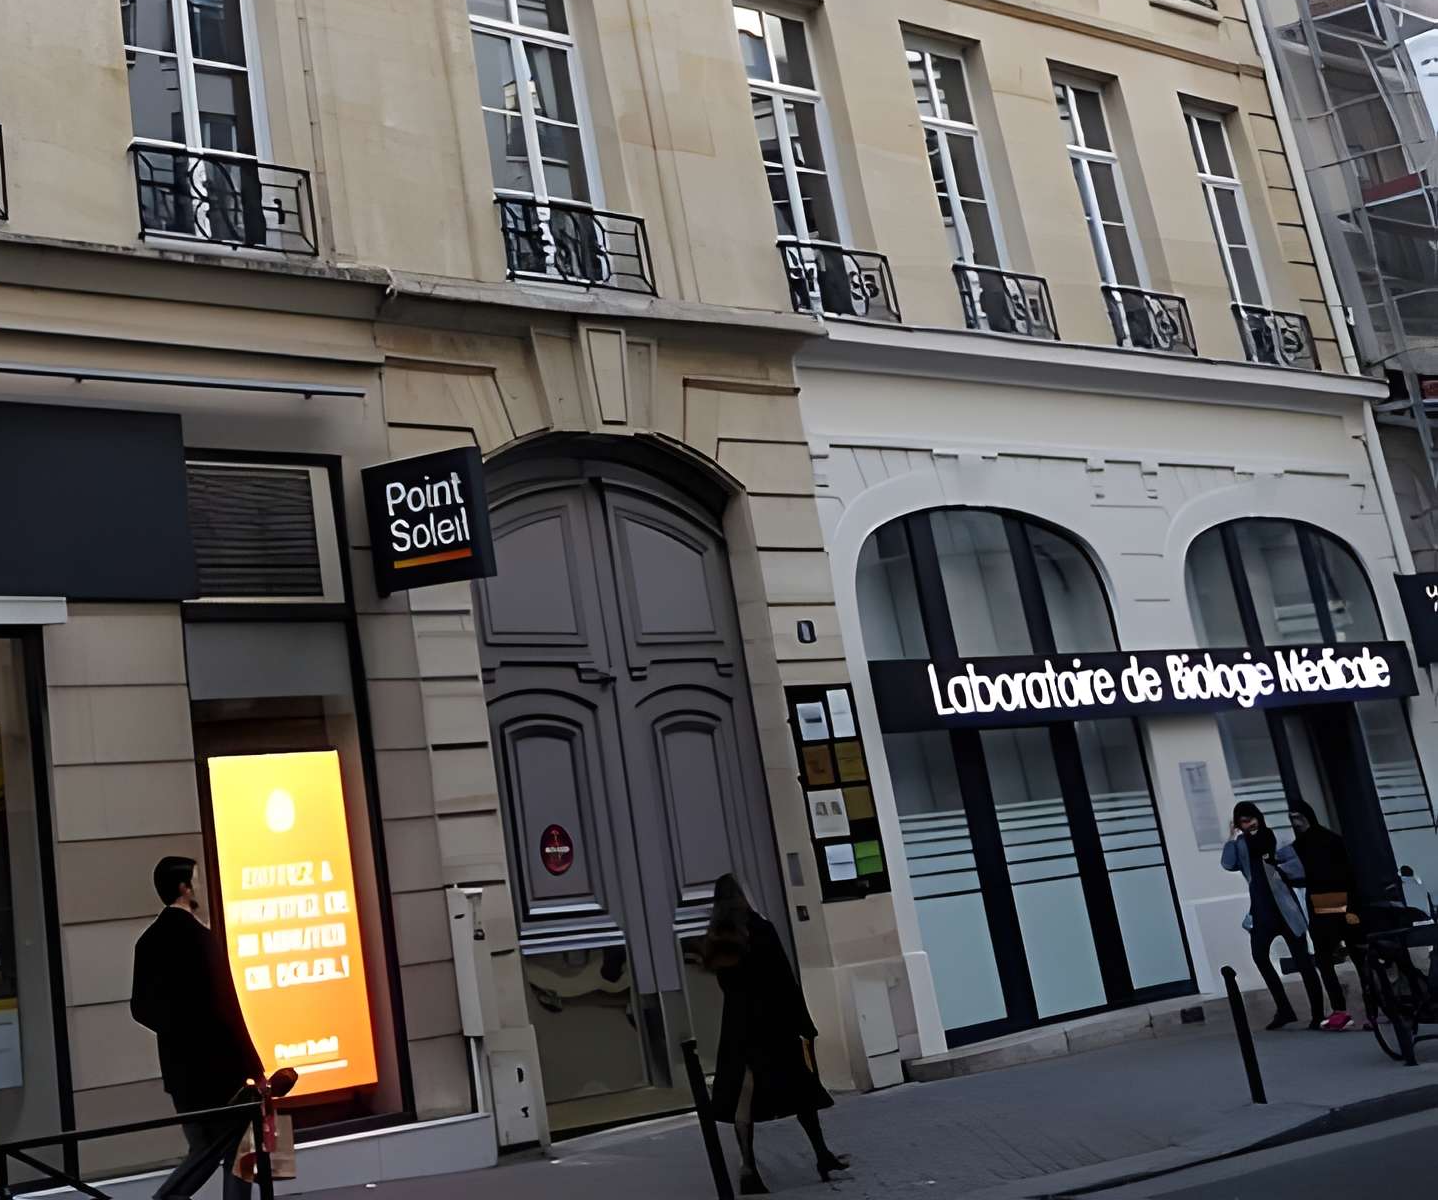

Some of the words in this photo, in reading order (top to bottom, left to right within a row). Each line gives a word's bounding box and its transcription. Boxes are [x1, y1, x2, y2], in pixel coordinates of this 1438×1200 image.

[385, 471, 465, 517] Point
[390, 506, 471, 552] Soleil
[927, 658, 1116, 716] Laboratoire
[1121, 655, 1163, 703] de
[1165, 651, 1275, 708] Biologie
